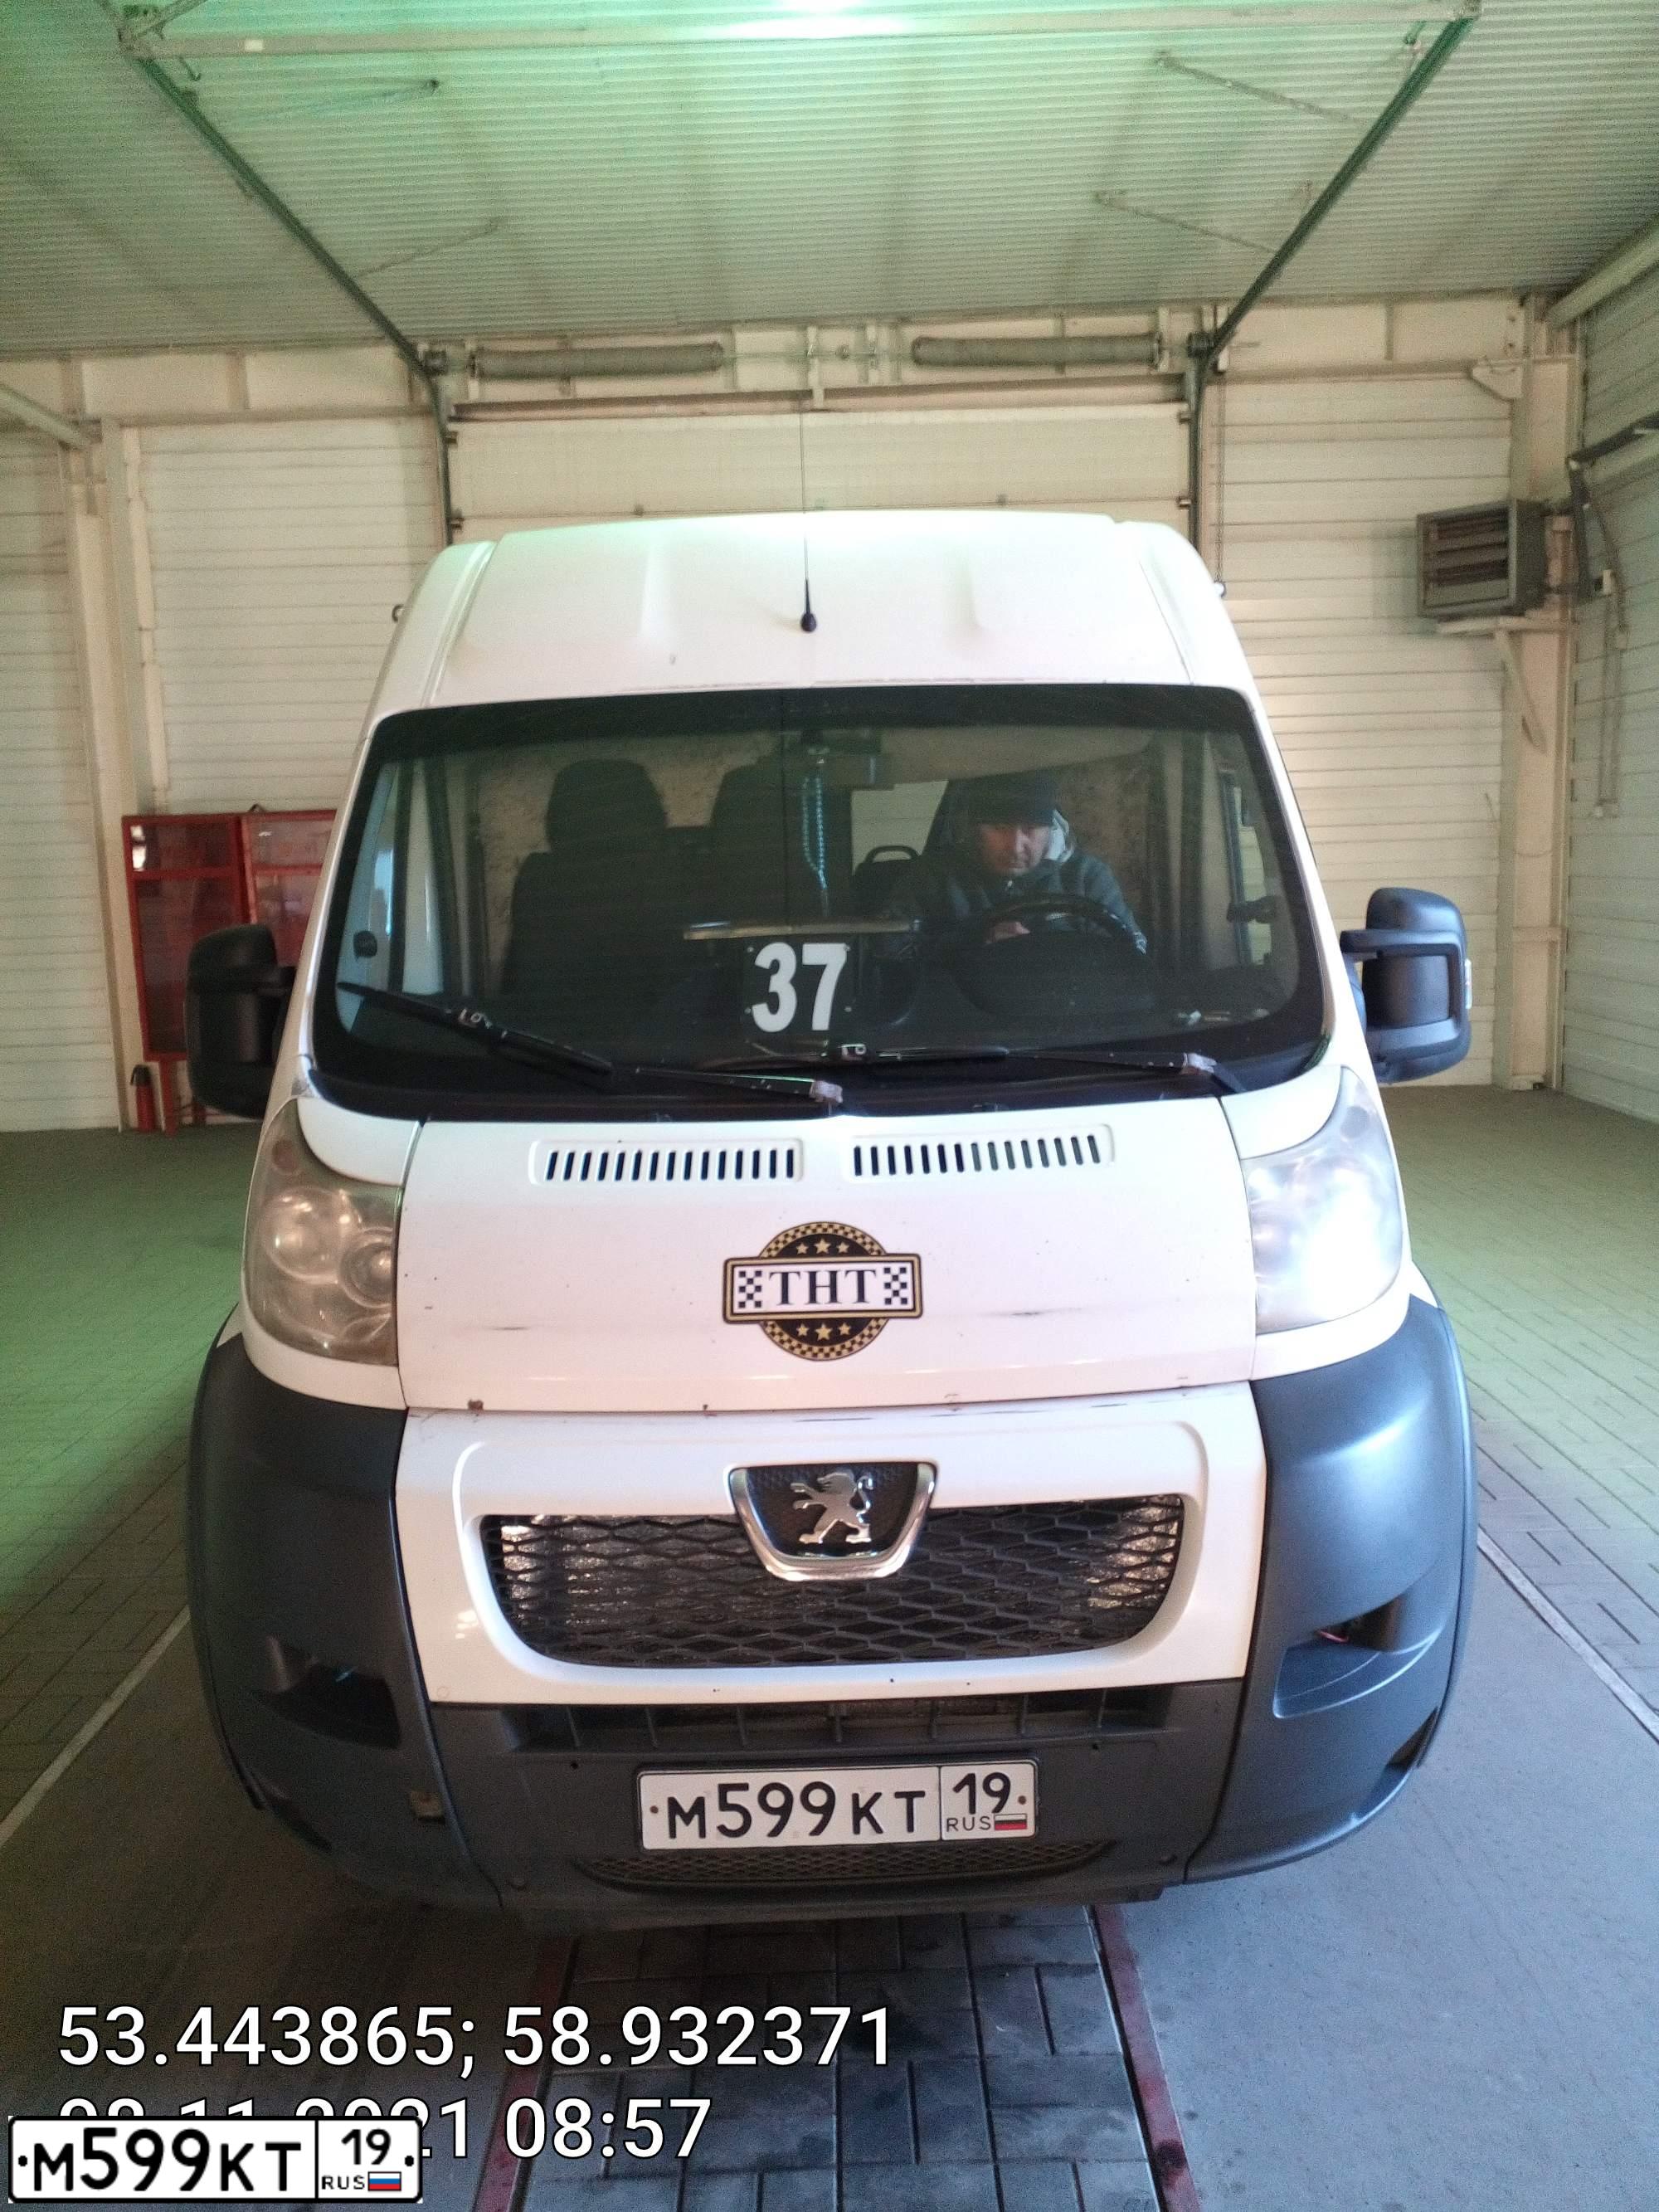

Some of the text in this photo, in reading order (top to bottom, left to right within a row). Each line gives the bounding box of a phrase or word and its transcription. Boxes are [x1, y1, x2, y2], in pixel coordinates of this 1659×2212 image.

[752, 942, 847, 1032] 37
[952, 1772, 1011, 1815] 19
[946, 1816, 991, 1833] RUS
